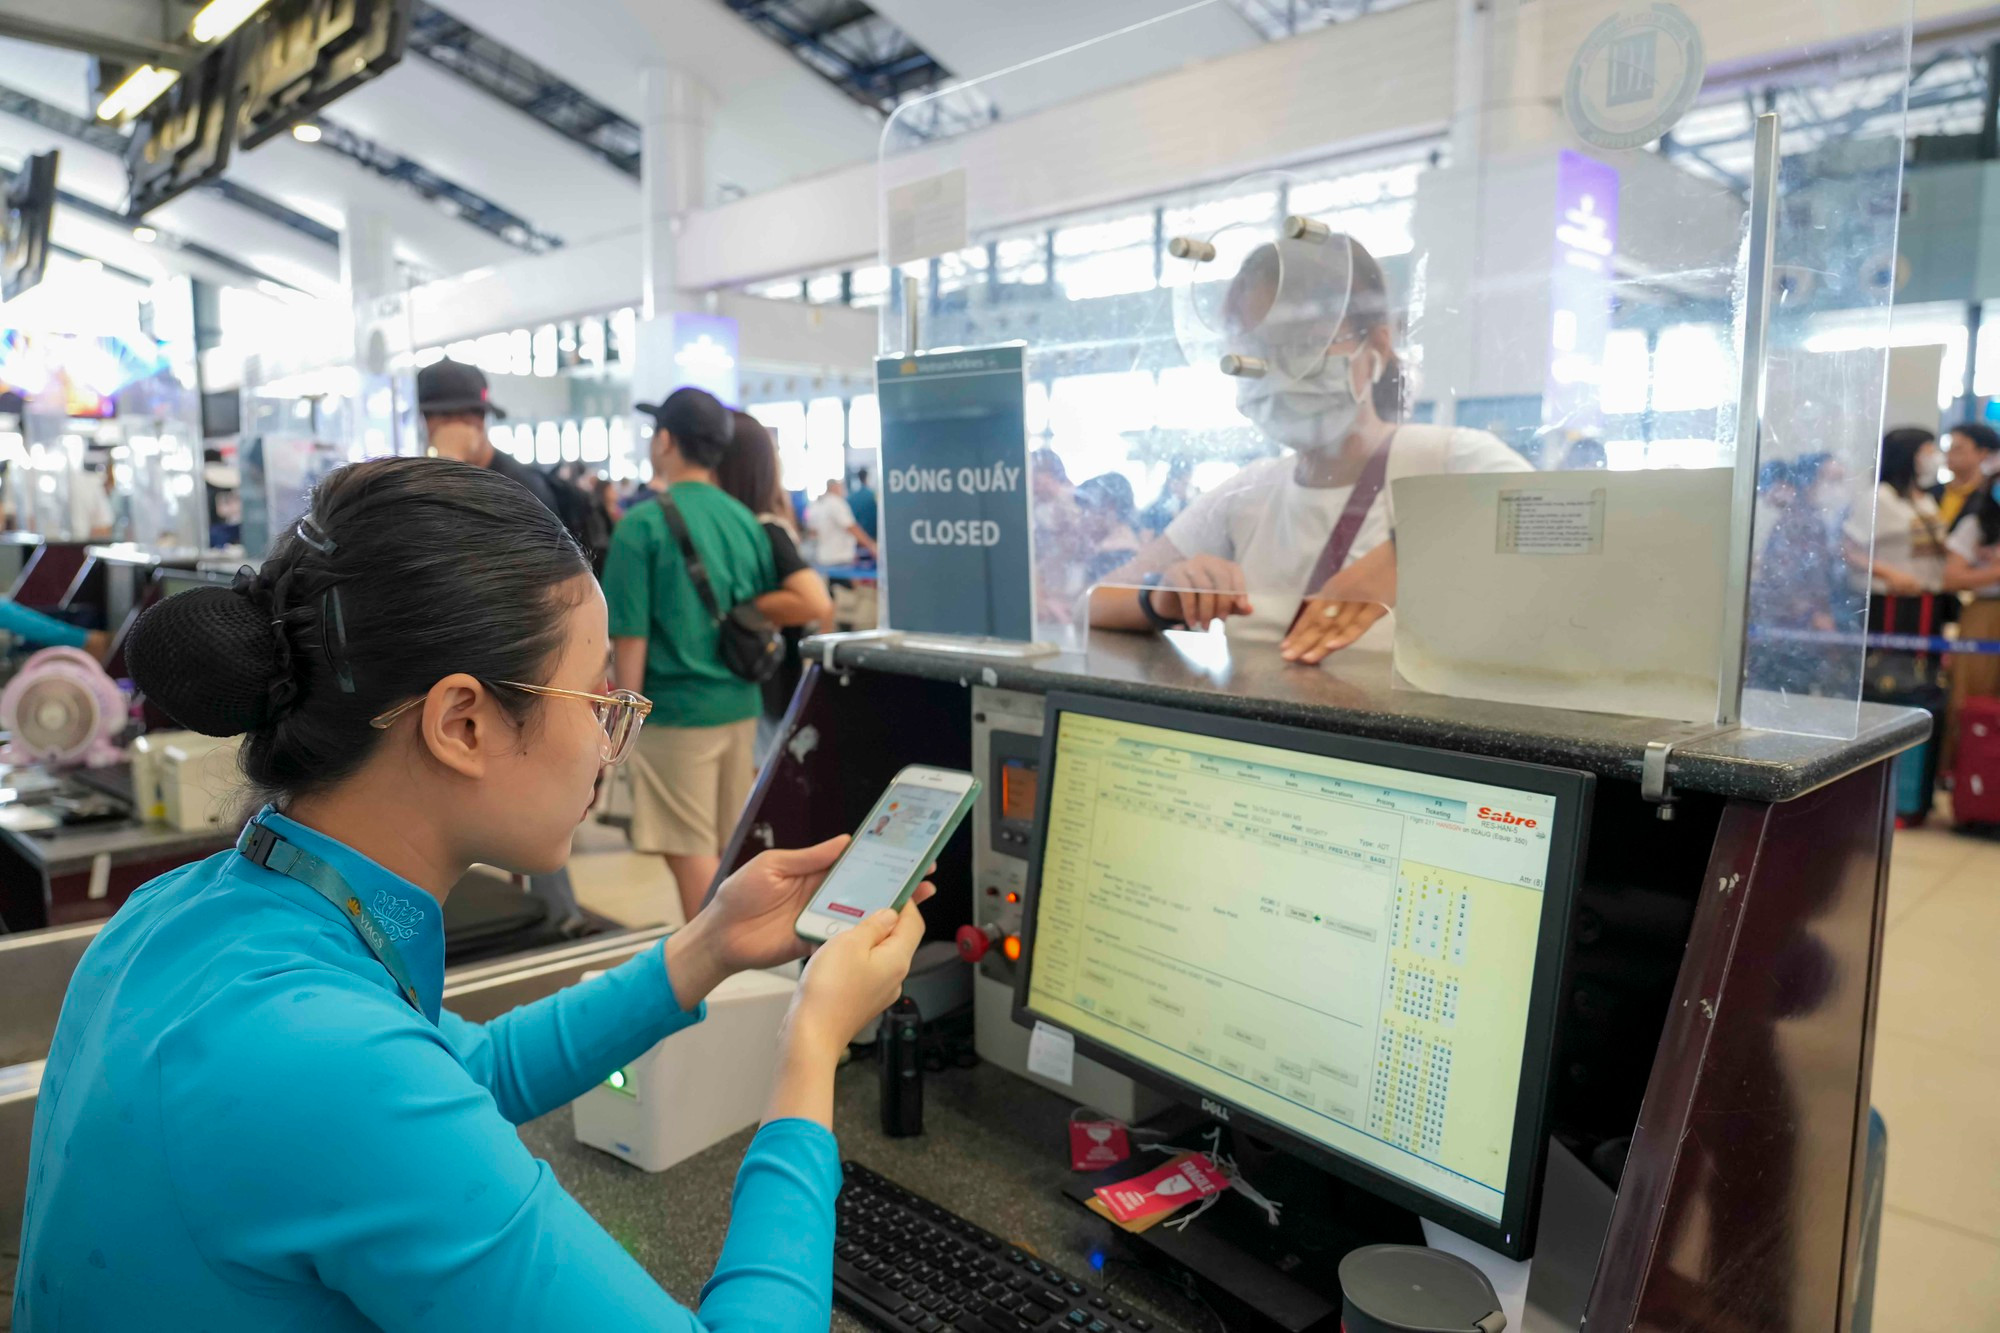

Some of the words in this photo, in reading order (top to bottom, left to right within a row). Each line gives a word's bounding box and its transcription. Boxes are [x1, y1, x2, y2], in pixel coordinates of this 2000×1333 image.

[889, 465, 952, 493] ĐÓNG
[910, 520, 1001, 546] CLOSED
[1376, 798, 1396, 808] Pricing
[1425, 807, 1451, 819] Ticketing
[1477, 806, 1537, 828] Sabre
[1481, 820, 1518, 834] RES-HAN-5
[1519, 875, 1532, 884] Attr
[1201, 1098, 1229, 1121] DELL
[1178, 1160, 1215, 1193] FRAGILE
